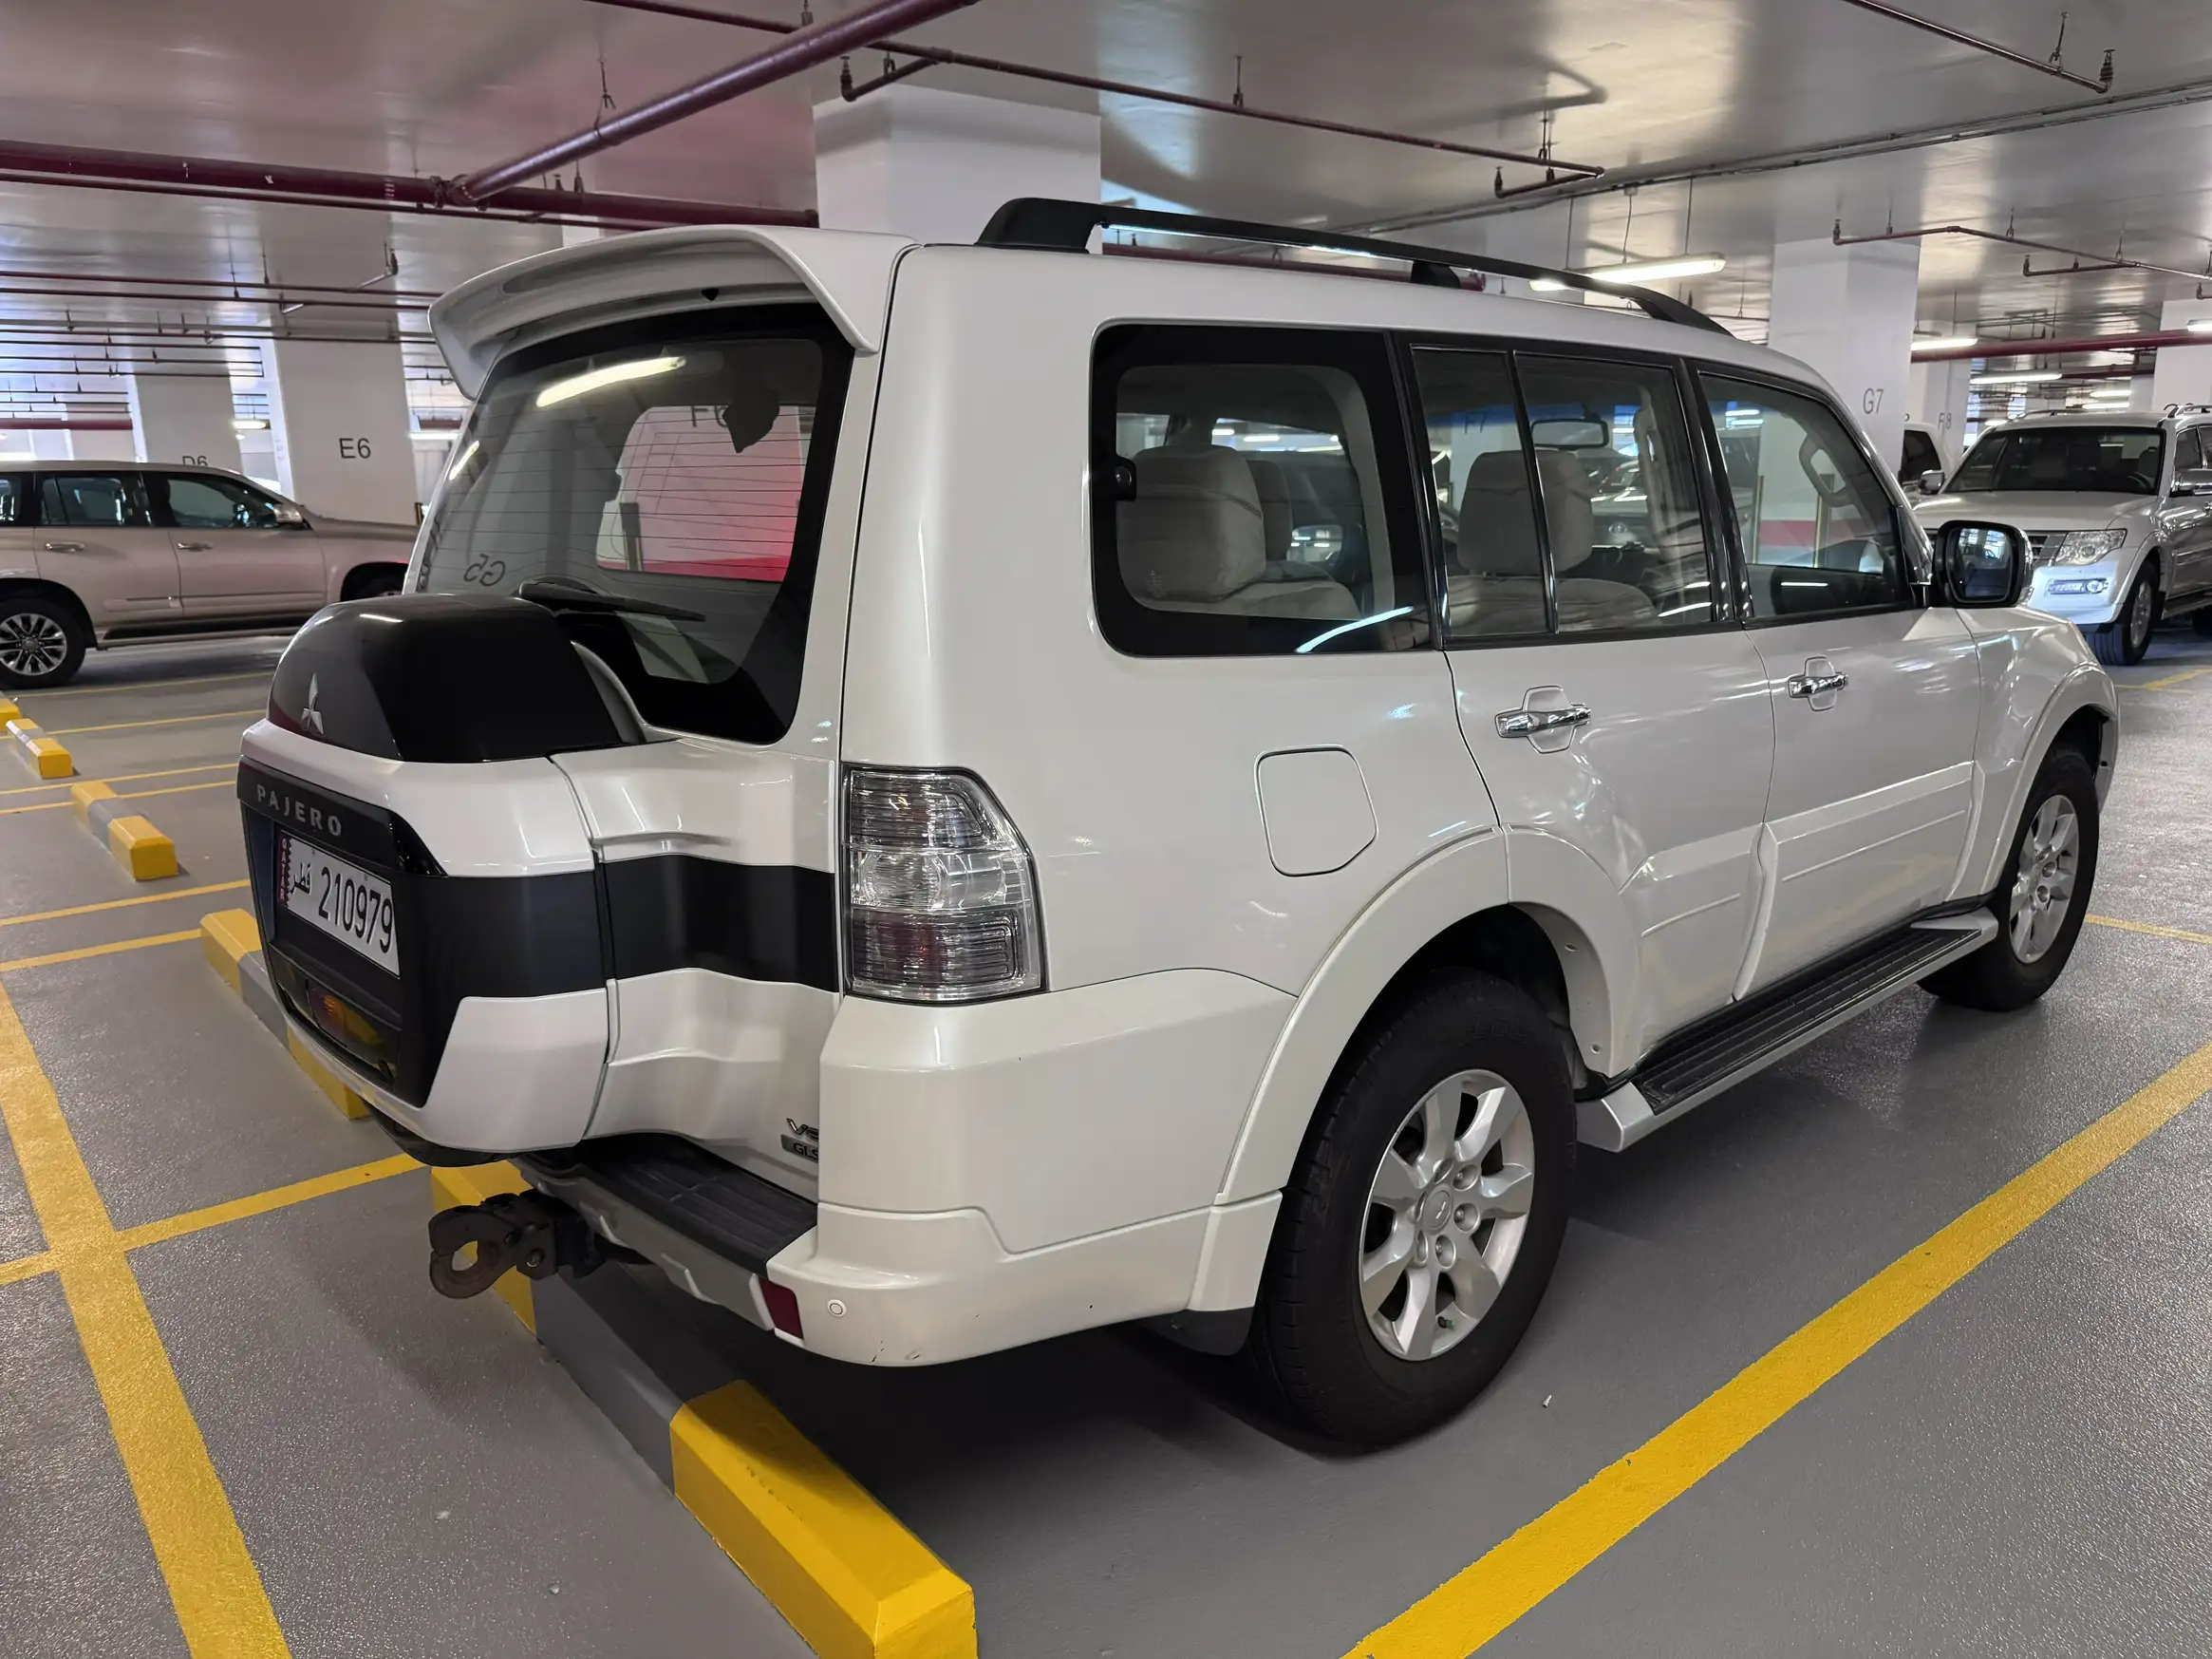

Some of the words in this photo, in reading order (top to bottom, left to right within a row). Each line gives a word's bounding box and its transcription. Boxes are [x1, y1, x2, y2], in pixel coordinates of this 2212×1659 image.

[1863, 387, 1884, 414] G7
[339, 438, 372, 459] E6
[256, 783, 342, 837] PAJERO
[279, 838, 289, 901] QATAR
[289, 861, 312, 895] قطر
[318, 865, 394, 954] 210979
